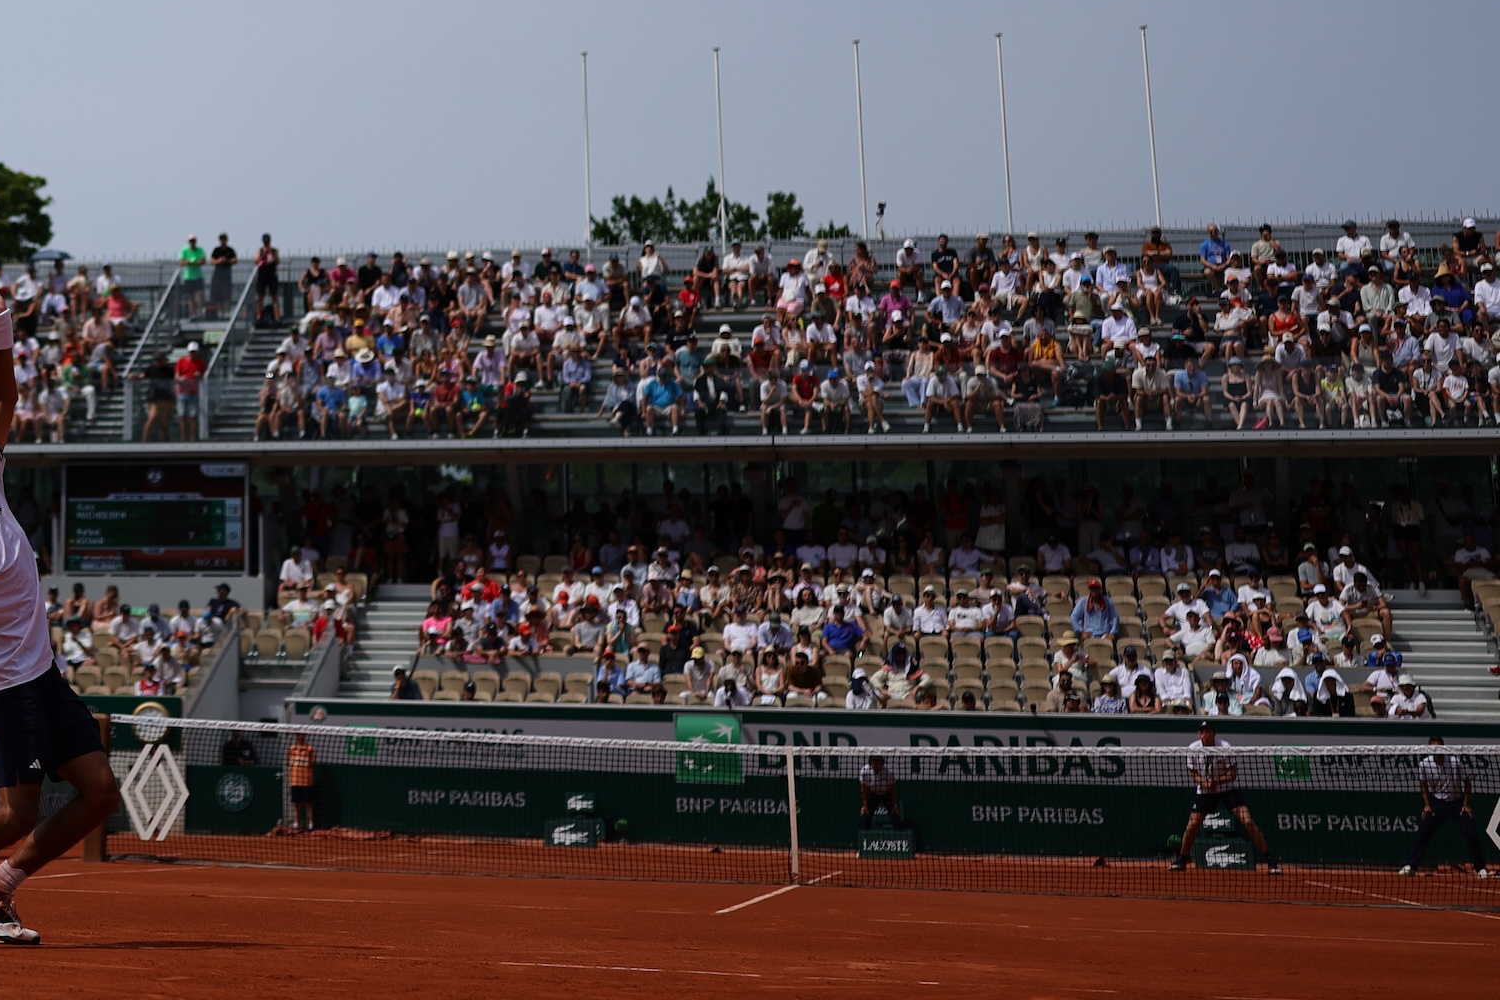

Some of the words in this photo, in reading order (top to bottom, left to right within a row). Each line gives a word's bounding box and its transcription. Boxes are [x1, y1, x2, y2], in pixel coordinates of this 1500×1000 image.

[758, 730, 858, 771] BNP
[909, 734, 1127, 779] PARIBAS
[407, 789, 446, 806] BNP
[449, 790, 526, 808] PARIBAS
[675, 797, 715, 814] BNP
[971, 805, 1012, 823] BNP
[1018, 806, 1105, 825] PARIBAS
[1277, 813, 1322, 831] BNP
[1327, 814, 1419, 833] PARIBAS
